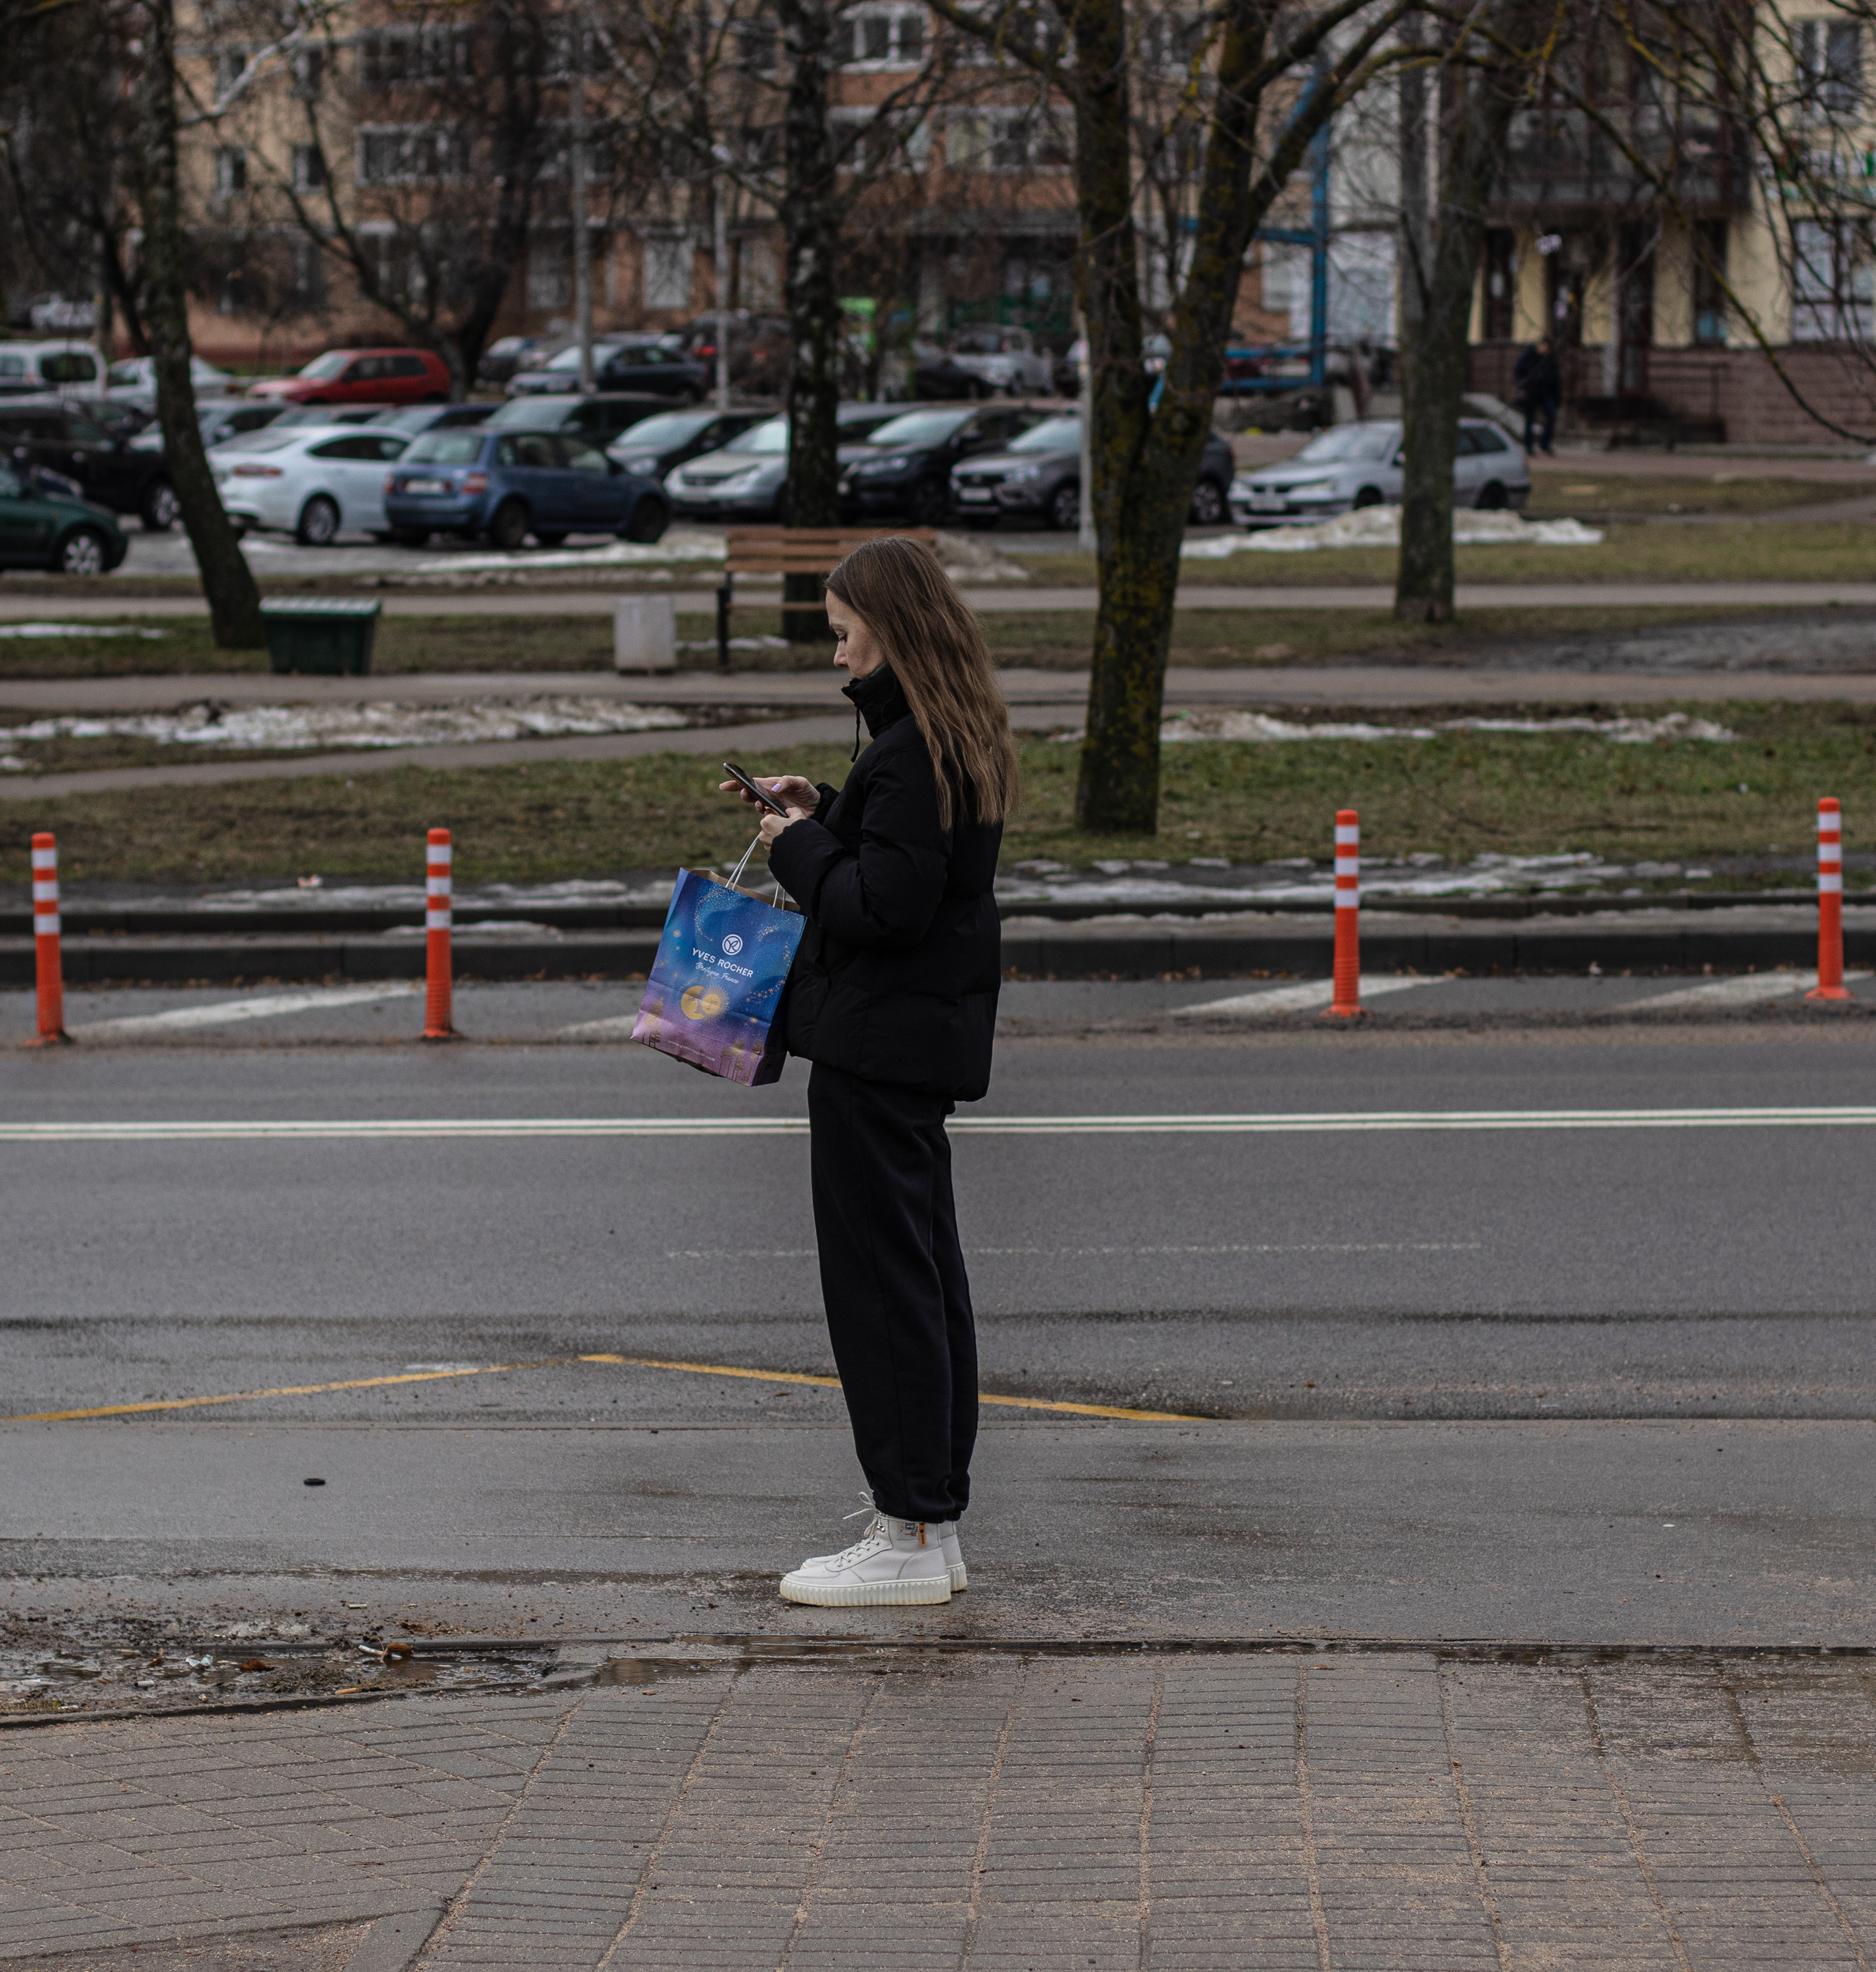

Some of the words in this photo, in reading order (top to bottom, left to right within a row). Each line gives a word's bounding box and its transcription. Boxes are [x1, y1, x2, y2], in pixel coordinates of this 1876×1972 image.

[692, 948, 716, 964] YVES
[717, 959, 754, 978] ROCHER
[720, 972, 739, 984] France
